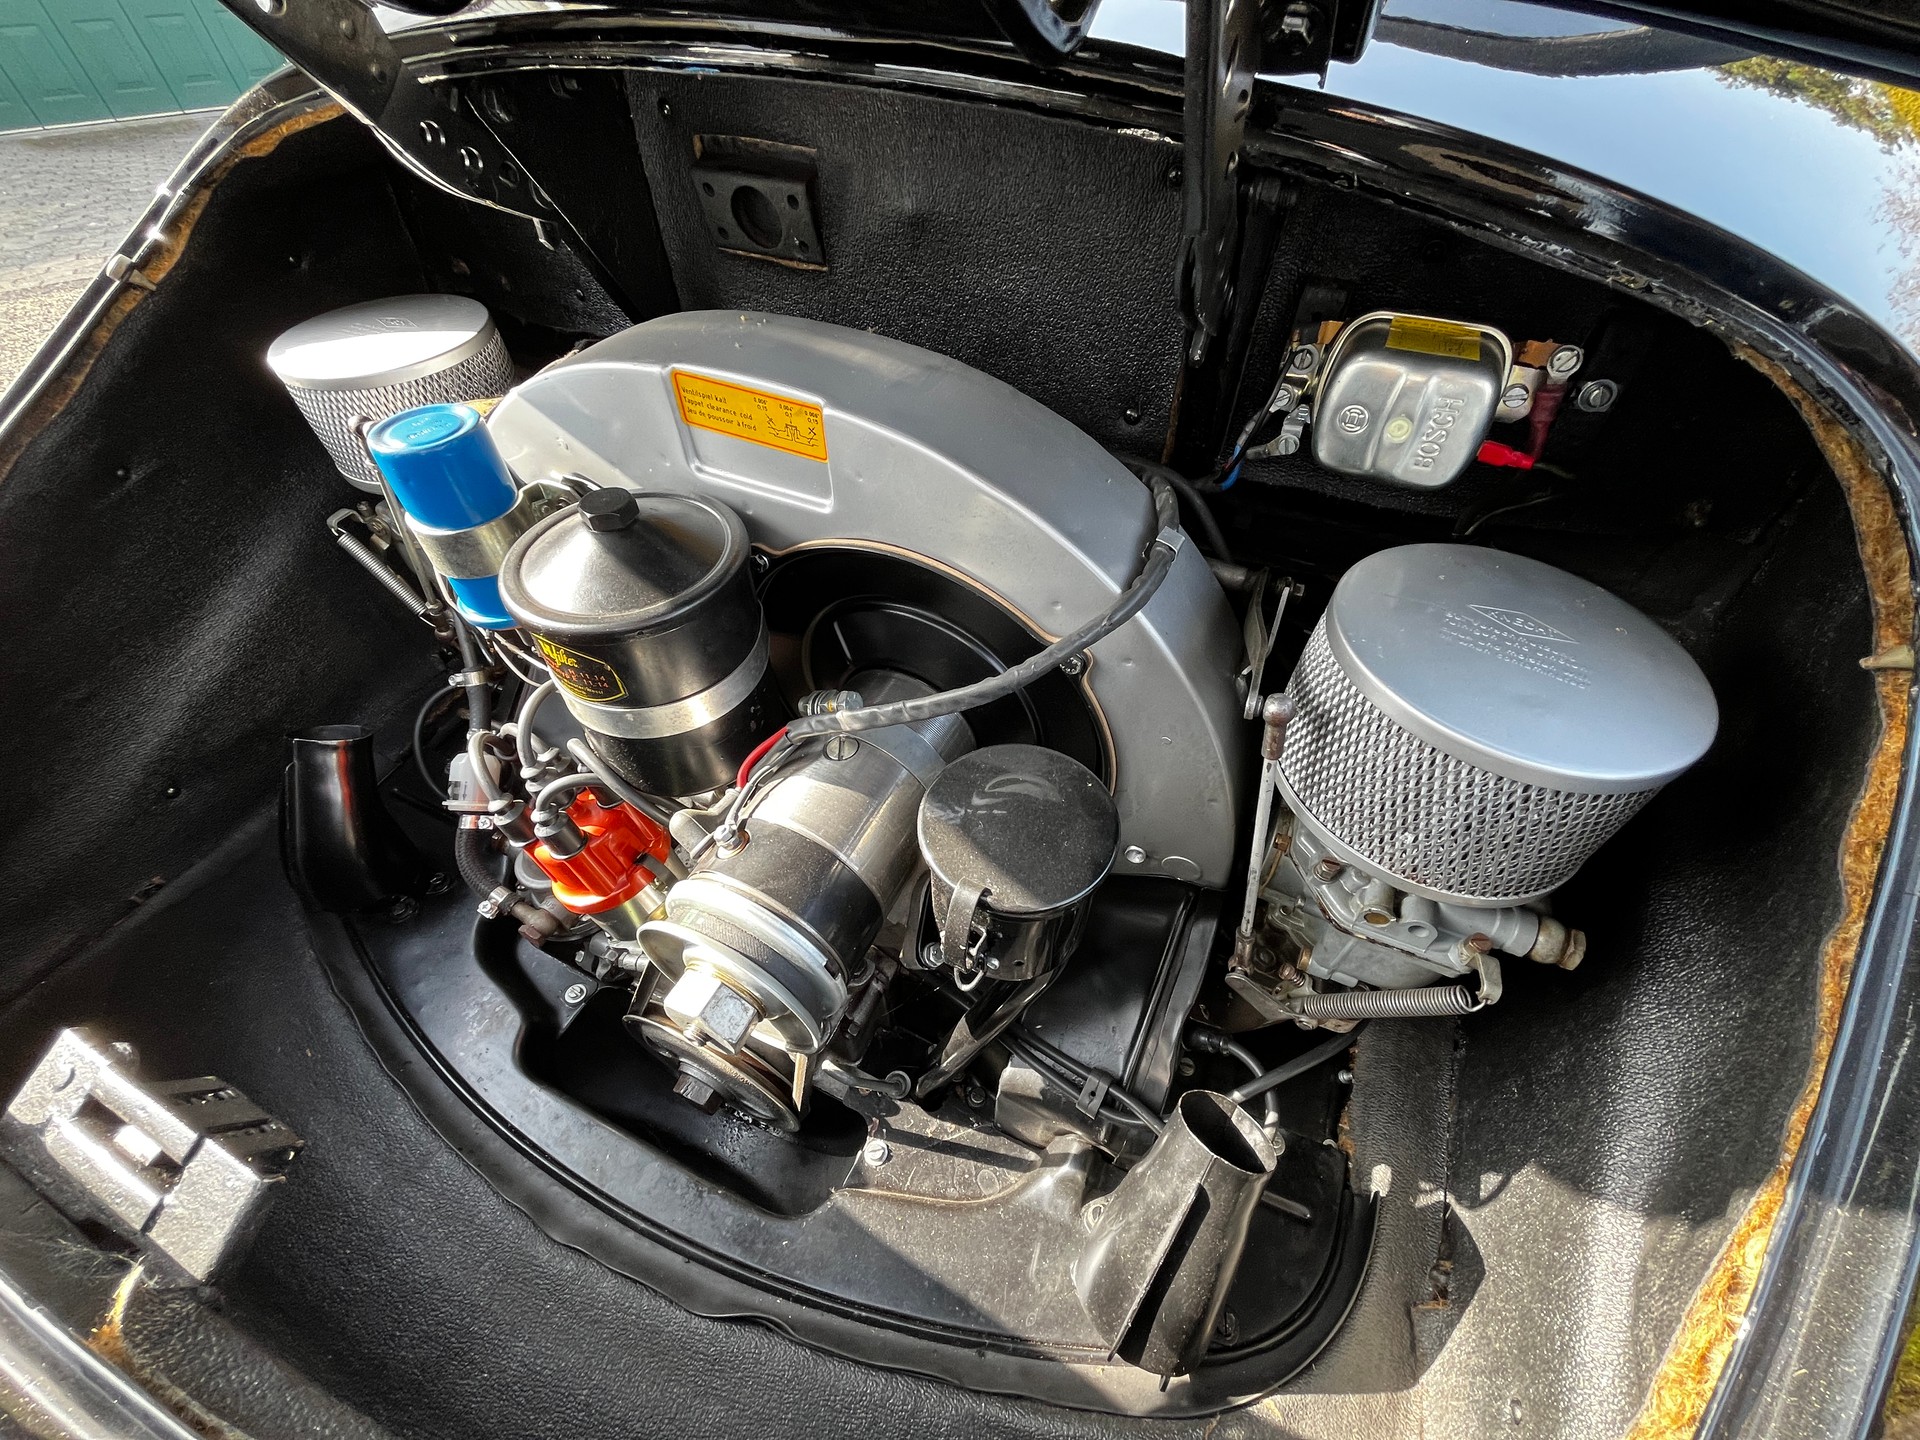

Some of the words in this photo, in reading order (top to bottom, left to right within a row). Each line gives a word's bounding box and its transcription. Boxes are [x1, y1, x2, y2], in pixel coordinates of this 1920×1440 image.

[681, 386, 713, 400] Ventilspiel
[683, 396, 704, 407] Tappet
[707, 403, 737, 416] clearance
[740, 412, 753, 421] cold
[687, 407, 697, 415] Jeu
[707, 414, 734, 424] poussoir
[1412, 397, 1464, 471] BOSCH
